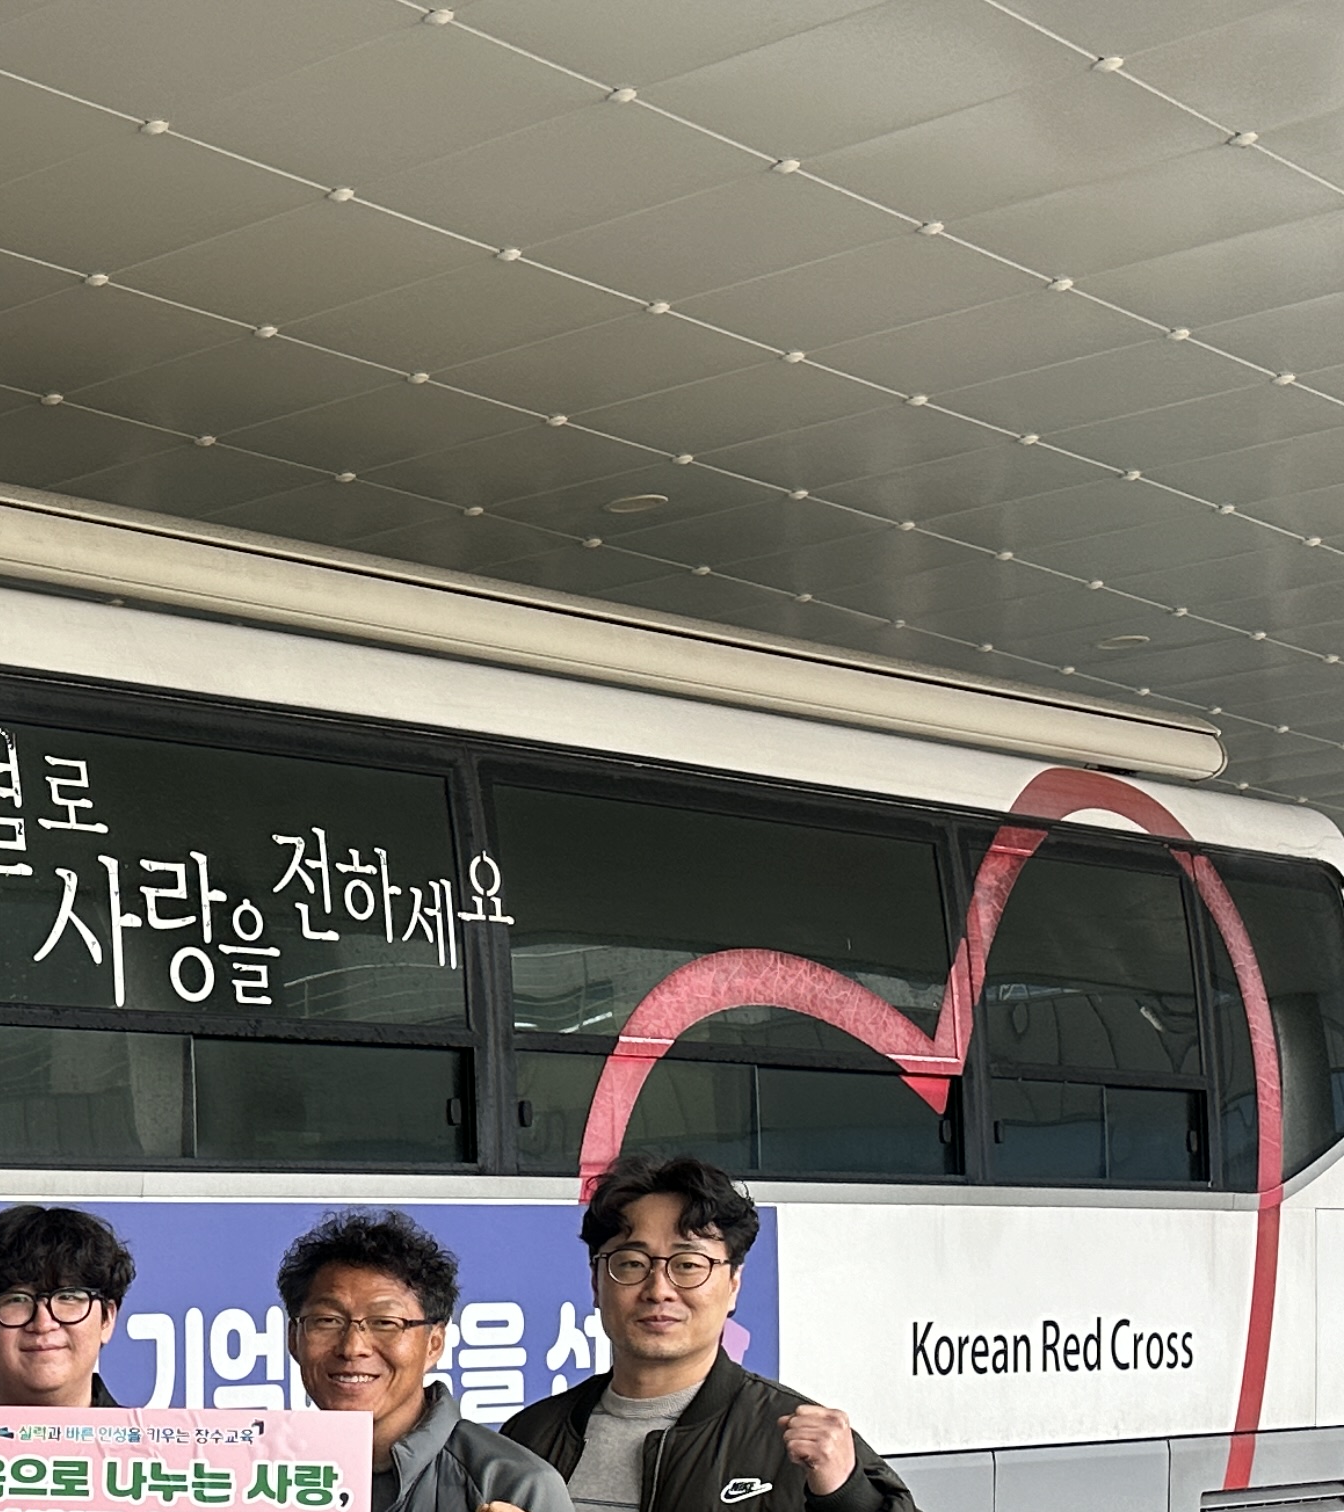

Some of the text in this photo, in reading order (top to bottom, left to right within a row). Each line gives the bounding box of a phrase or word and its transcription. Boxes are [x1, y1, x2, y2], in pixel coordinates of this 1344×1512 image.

[34, 852, 281, 1007] 사랑을
[272, 826, 515, 969] 전하세요
[912, 1317, 1194, 1375] Korean Red Cross
[19, 1426, 255, 1445] 실력과 바른 인성을 키우는 장수교육
[106, 1461, 231, 1502] 나누는
[247, 1464, 350, 1508] 사랑,
